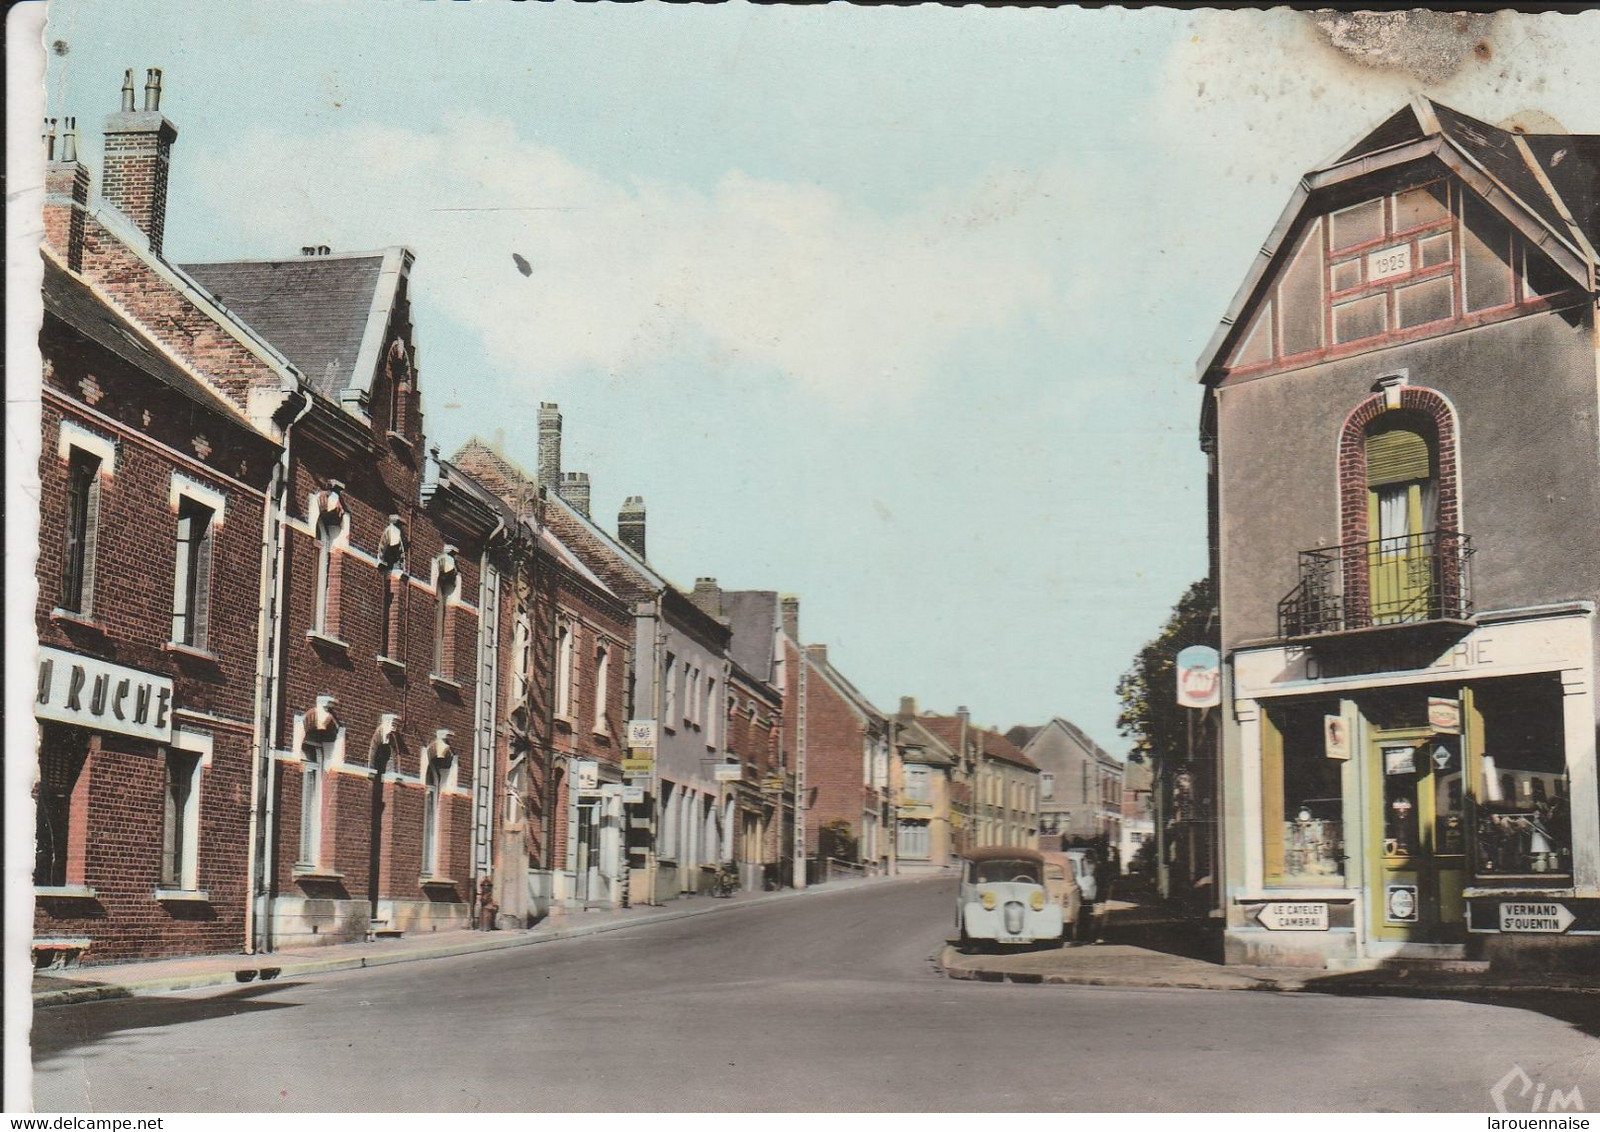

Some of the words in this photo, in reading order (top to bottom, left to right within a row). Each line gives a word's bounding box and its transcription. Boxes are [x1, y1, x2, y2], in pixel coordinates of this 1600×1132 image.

[64, 664, 171, 729] RUCHE
[1273, 905, 1284, 915] LE
[1287, 905, 1324, 915] CATELET
[1505, 905, 1558, 916] VERMAND
[1279, 917, 1320, 927] CAMBRAI
[1515, 918, 1560, 930] QUENTIN
